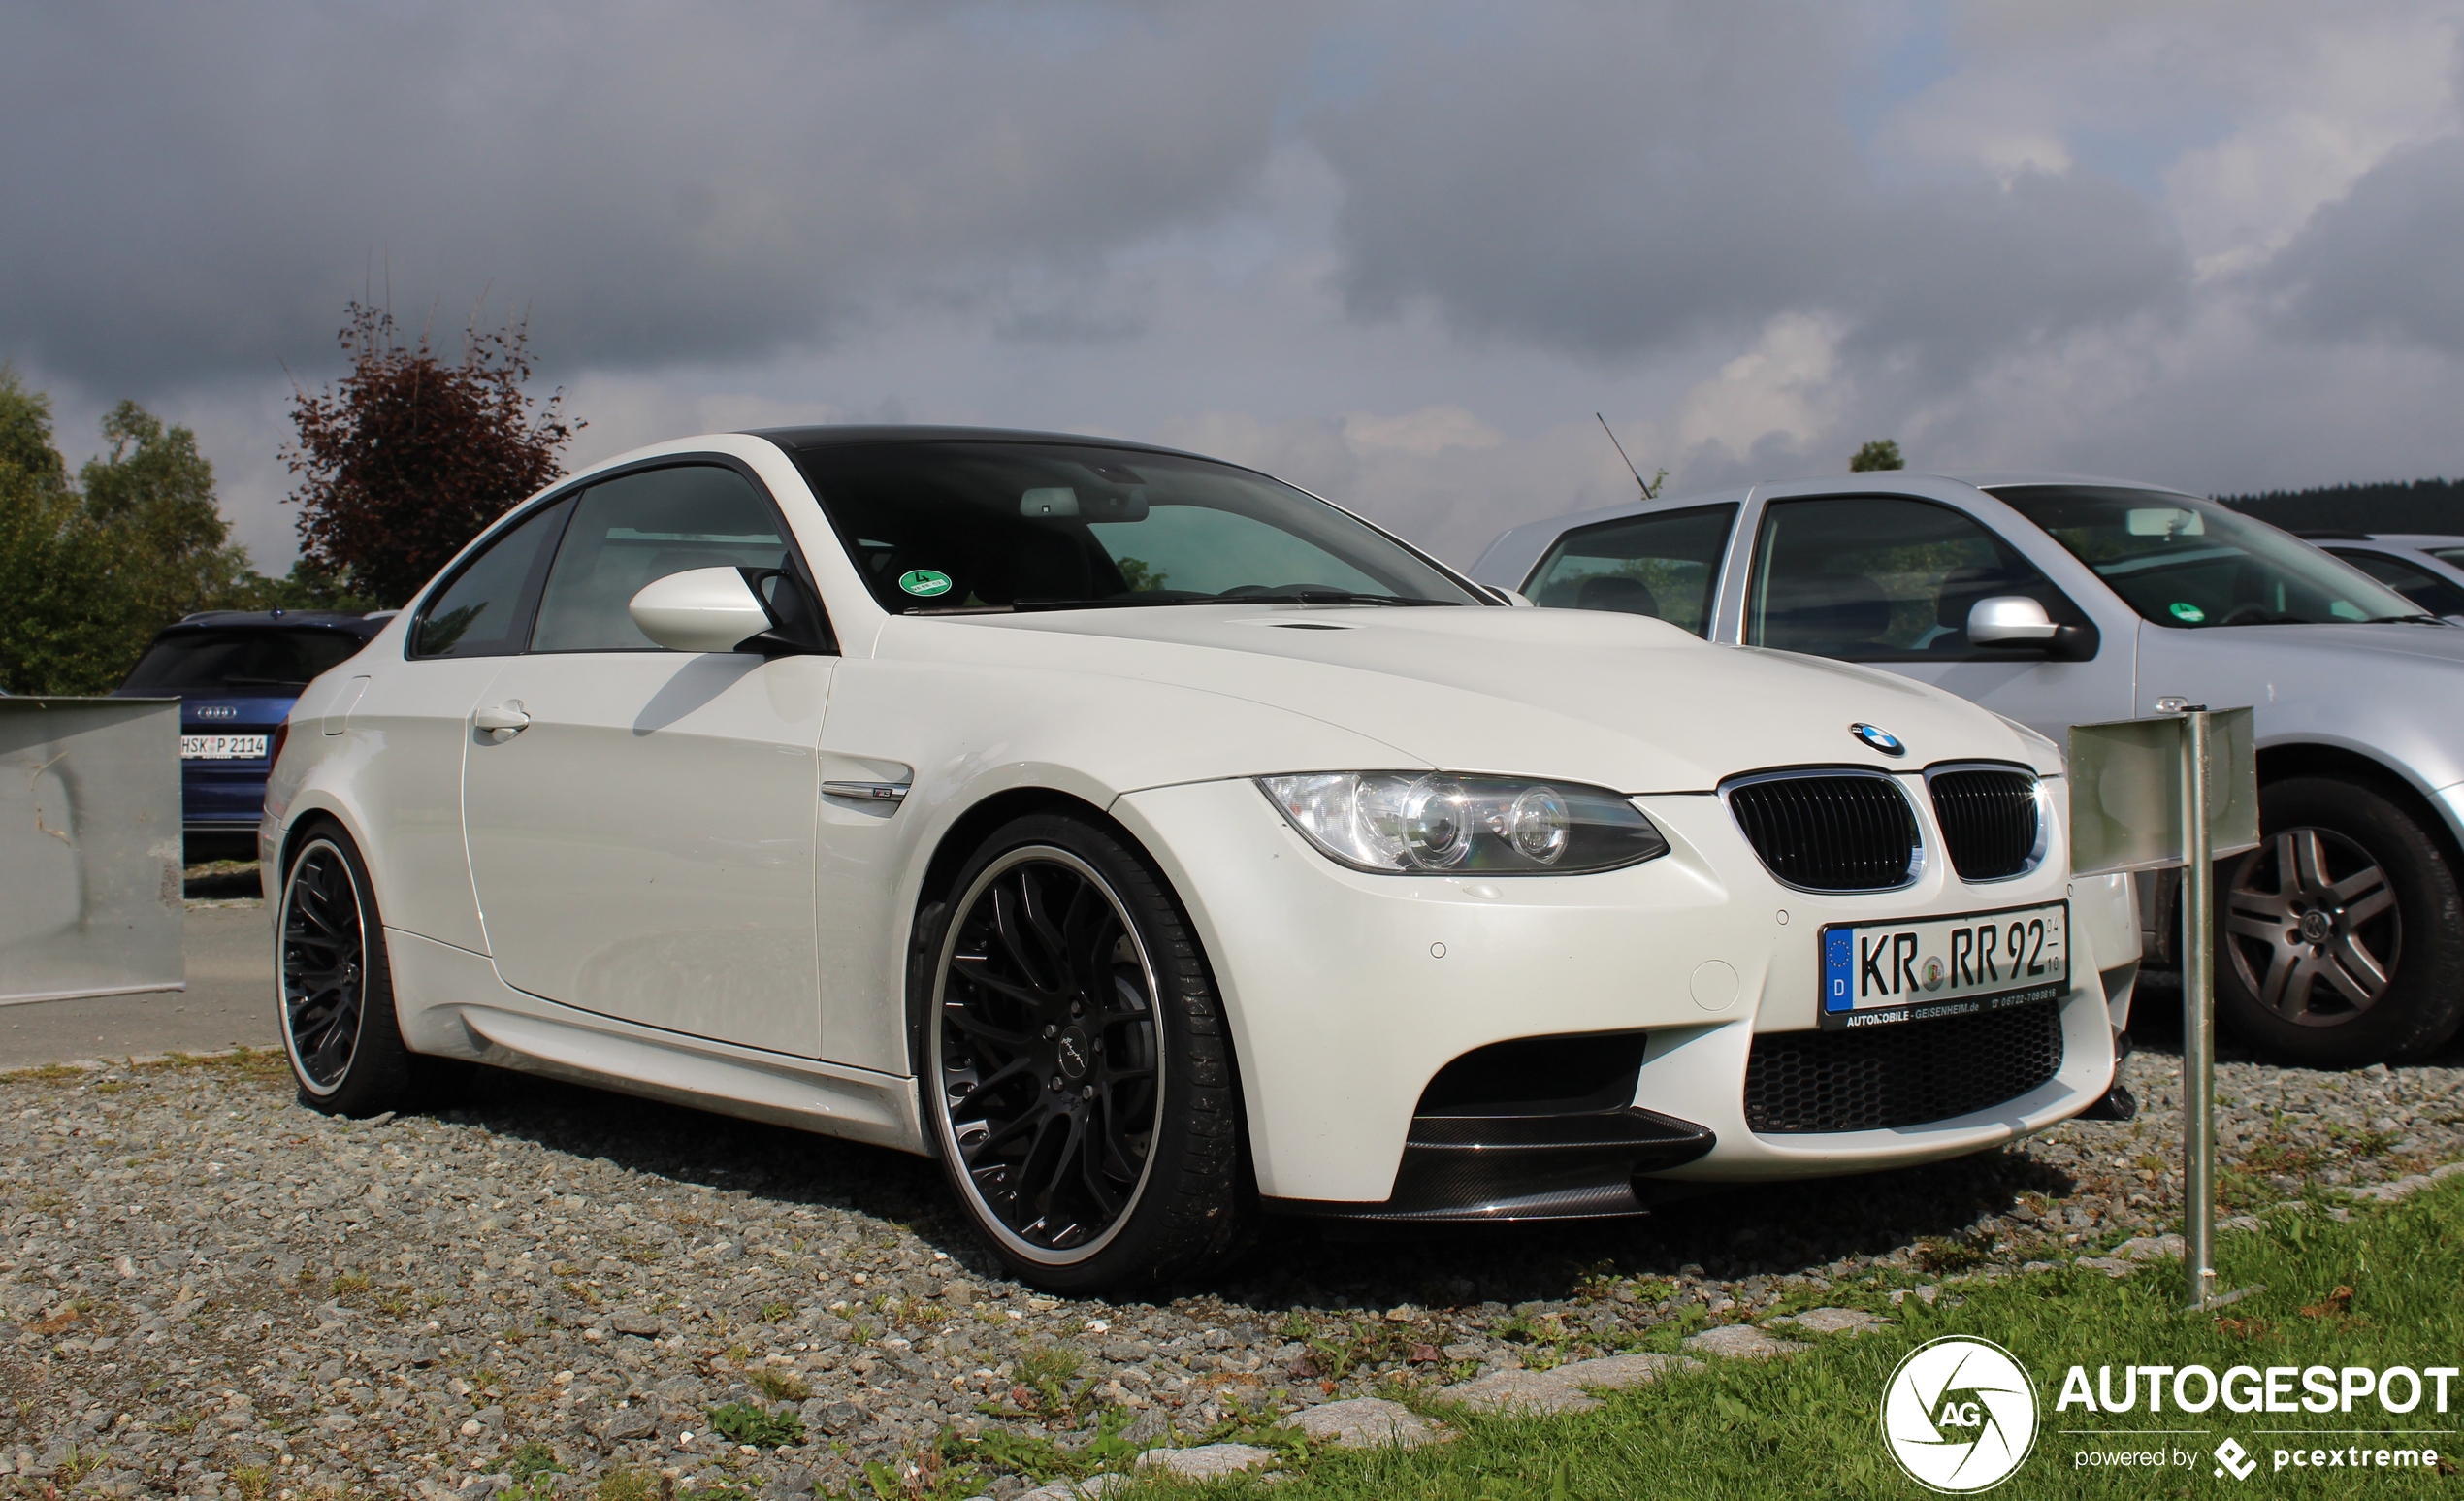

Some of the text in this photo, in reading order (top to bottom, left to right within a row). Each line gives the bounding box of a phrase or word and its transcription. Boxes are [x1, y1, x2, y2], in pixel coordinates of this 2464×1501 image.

[181, 737, 264, 753] HSK P 2114
[1861, 932, 1920, 997] KR
[1951, 925, 1998, 988] RR
[2007, 919, 2045, 977] 92
[2046, 956, 2059, 973] 10
[1834, 979, 1844, 996] D
[1915, 1002, 1980, 1020] GEISENHEIM.de
